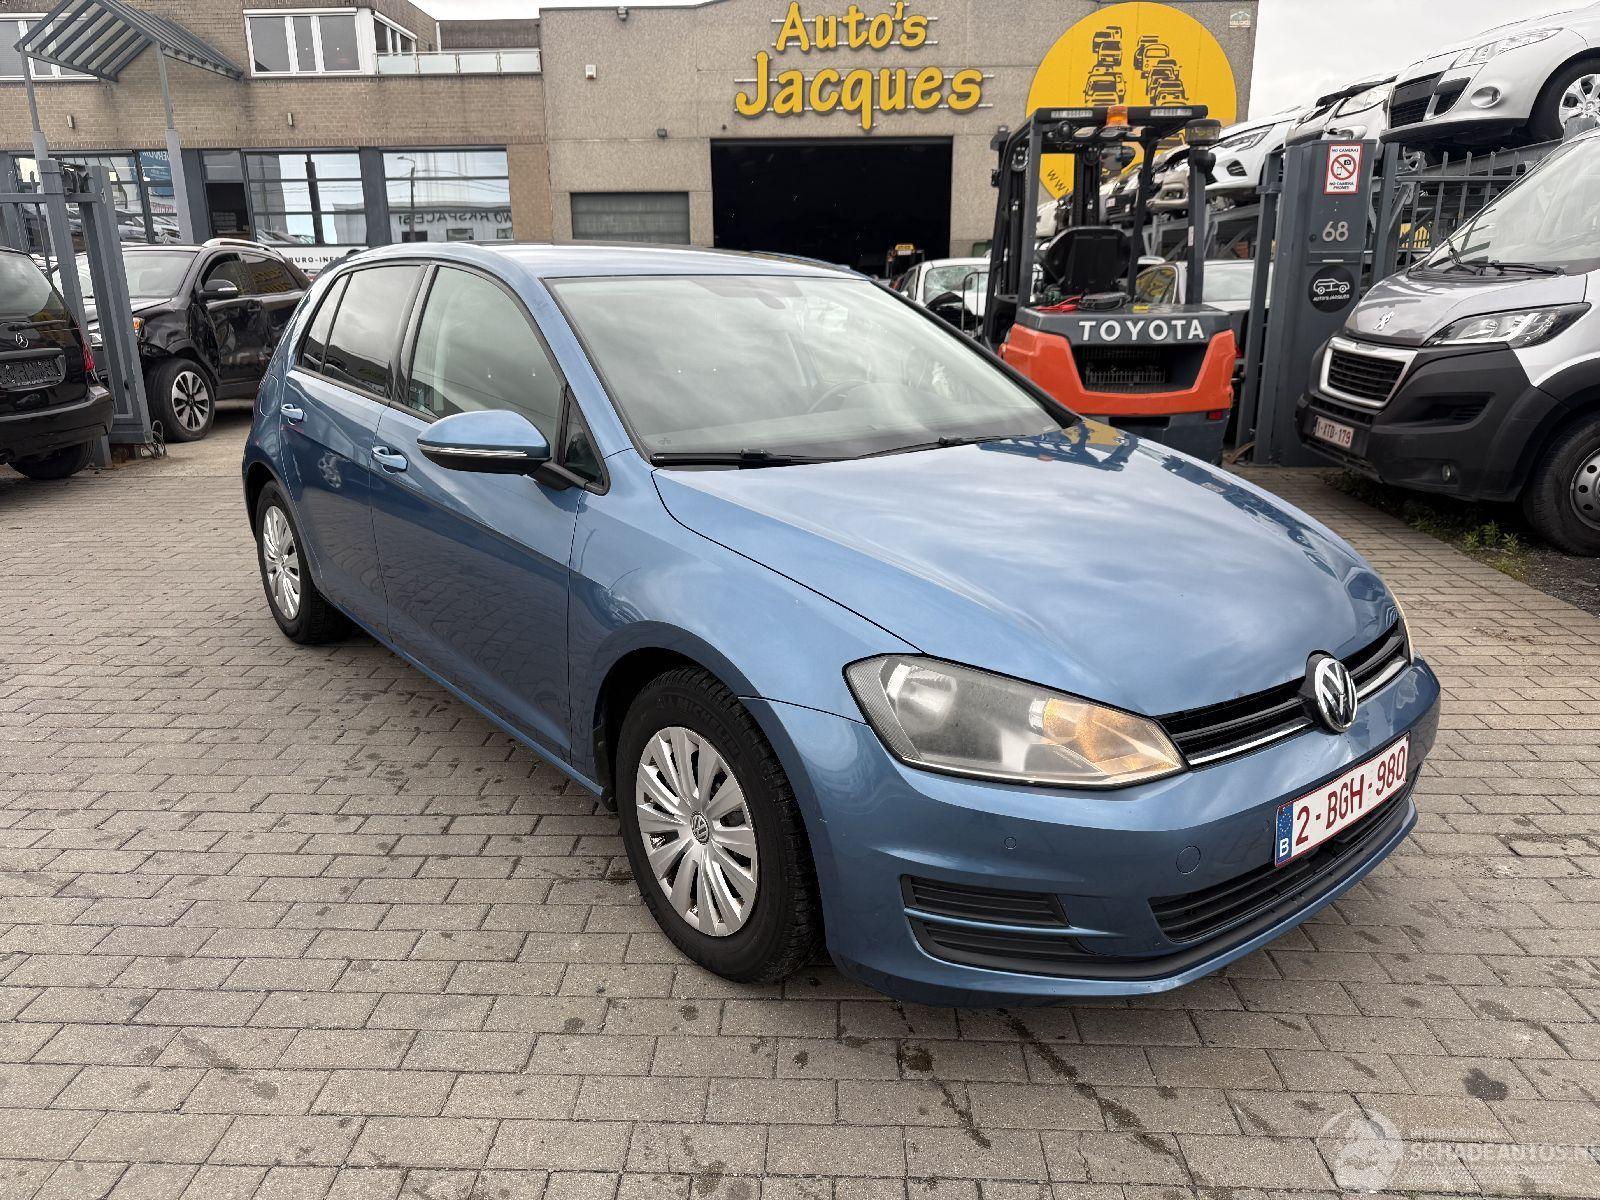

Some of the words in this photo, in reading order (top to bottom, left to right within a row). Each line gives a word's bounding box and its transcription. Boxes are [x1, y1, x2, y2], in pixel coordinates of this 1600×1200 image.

[775, 1, 928, 51] Auto's
[735, 51, 983, 130] Jacques
[1322, 221, 1349, 242] 68
[1079, 319, 1205, 341] TOYOTA
[1295, 745, 1407, 847] 2-BGH-980
[1279, 837, 1290, 858] B
